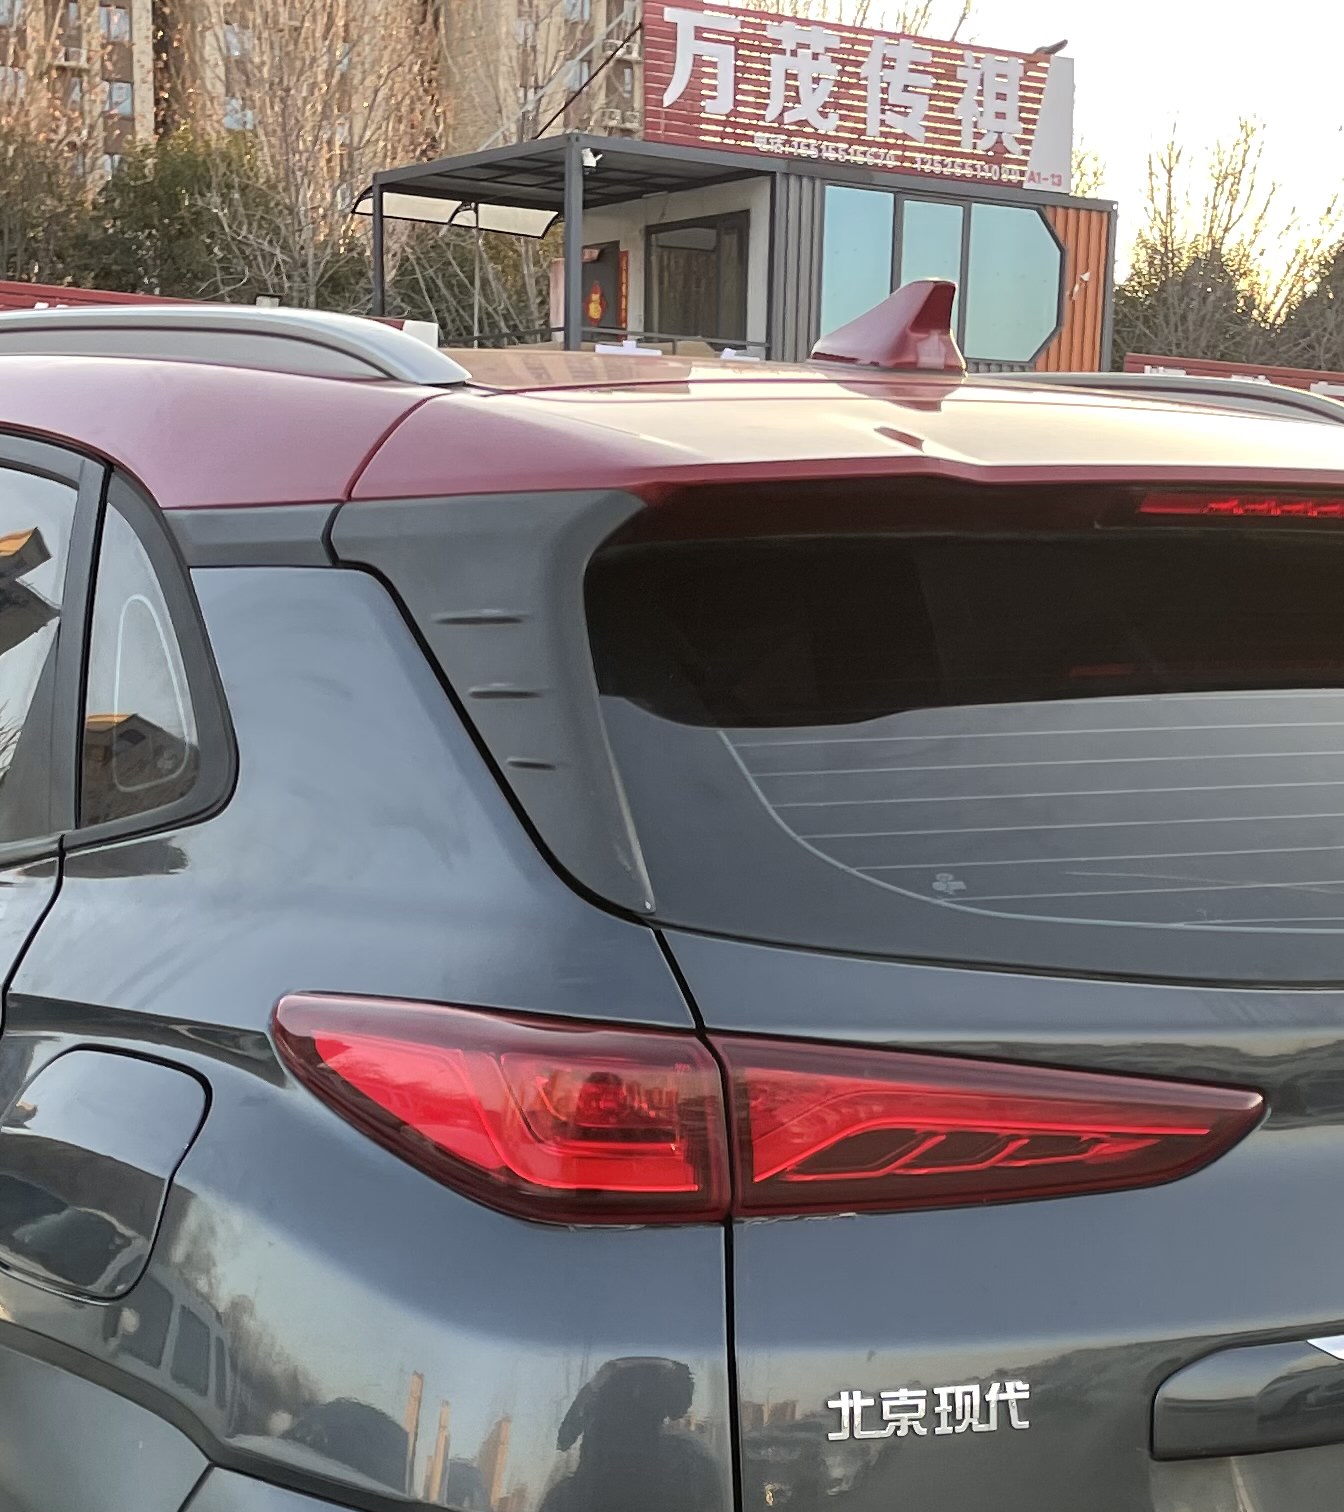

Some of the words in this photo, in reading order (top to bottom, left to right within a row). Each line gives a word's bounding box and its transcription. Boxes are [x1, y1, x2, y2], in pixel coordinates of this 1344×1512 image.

[662, 7, 1025, 156] 万茂传祺
[826, 1379, 1031, 1441] 北京现代
